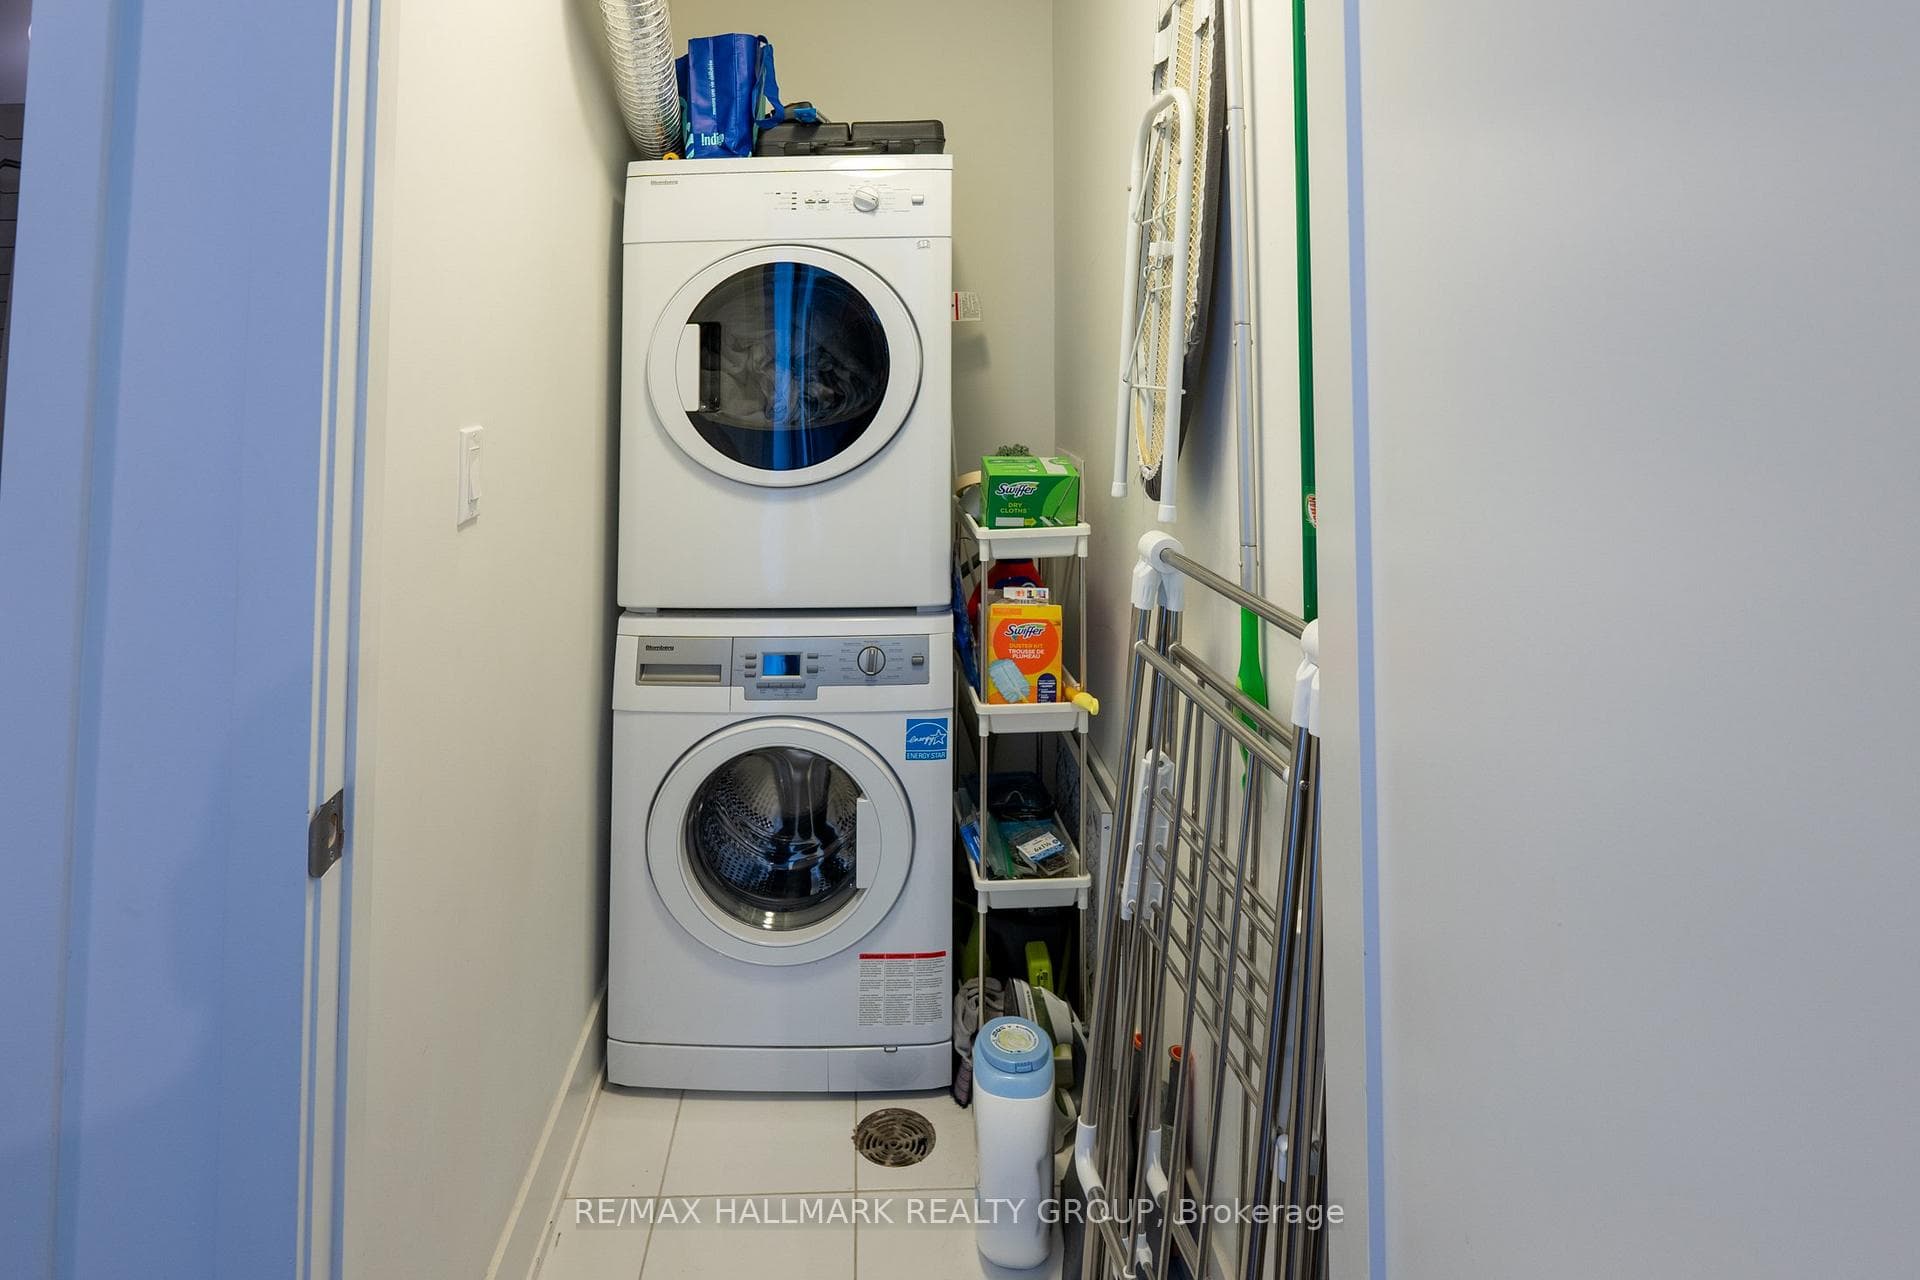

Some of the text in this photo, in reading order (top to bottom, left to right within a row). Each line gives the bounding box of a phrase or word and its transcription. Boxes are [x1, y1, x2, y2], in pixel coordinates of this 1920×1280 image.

[995, 482, 1038, 498] Swiffer
[1004, 624, 1046, 640] Swiffer
[907, 751, 946, 760] ENERGY STAR
